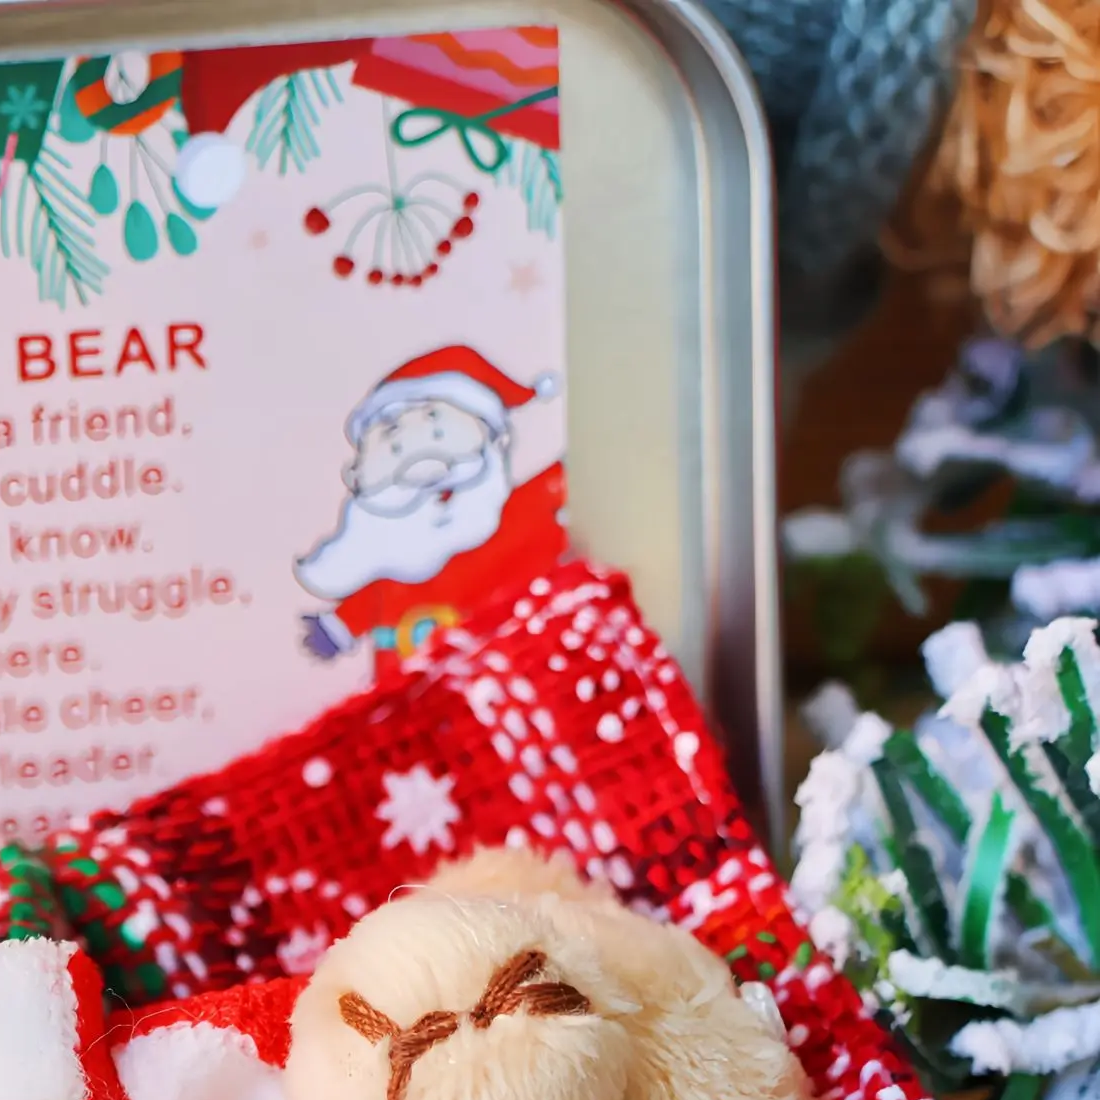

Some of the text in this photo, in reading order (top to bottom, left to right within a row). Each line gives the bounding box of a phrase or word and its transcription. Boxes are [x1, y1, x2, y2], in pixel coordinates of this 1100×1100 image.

[17, 322, 208, 383] BEAR
[31, 395, 193, 444] friend.
[0, 457, 183, 506] cuddle.
[9, 521, 154, 562] know.
[30, 566, 252, 621] struggle.
[59, 686, 213, 730] cheer.
